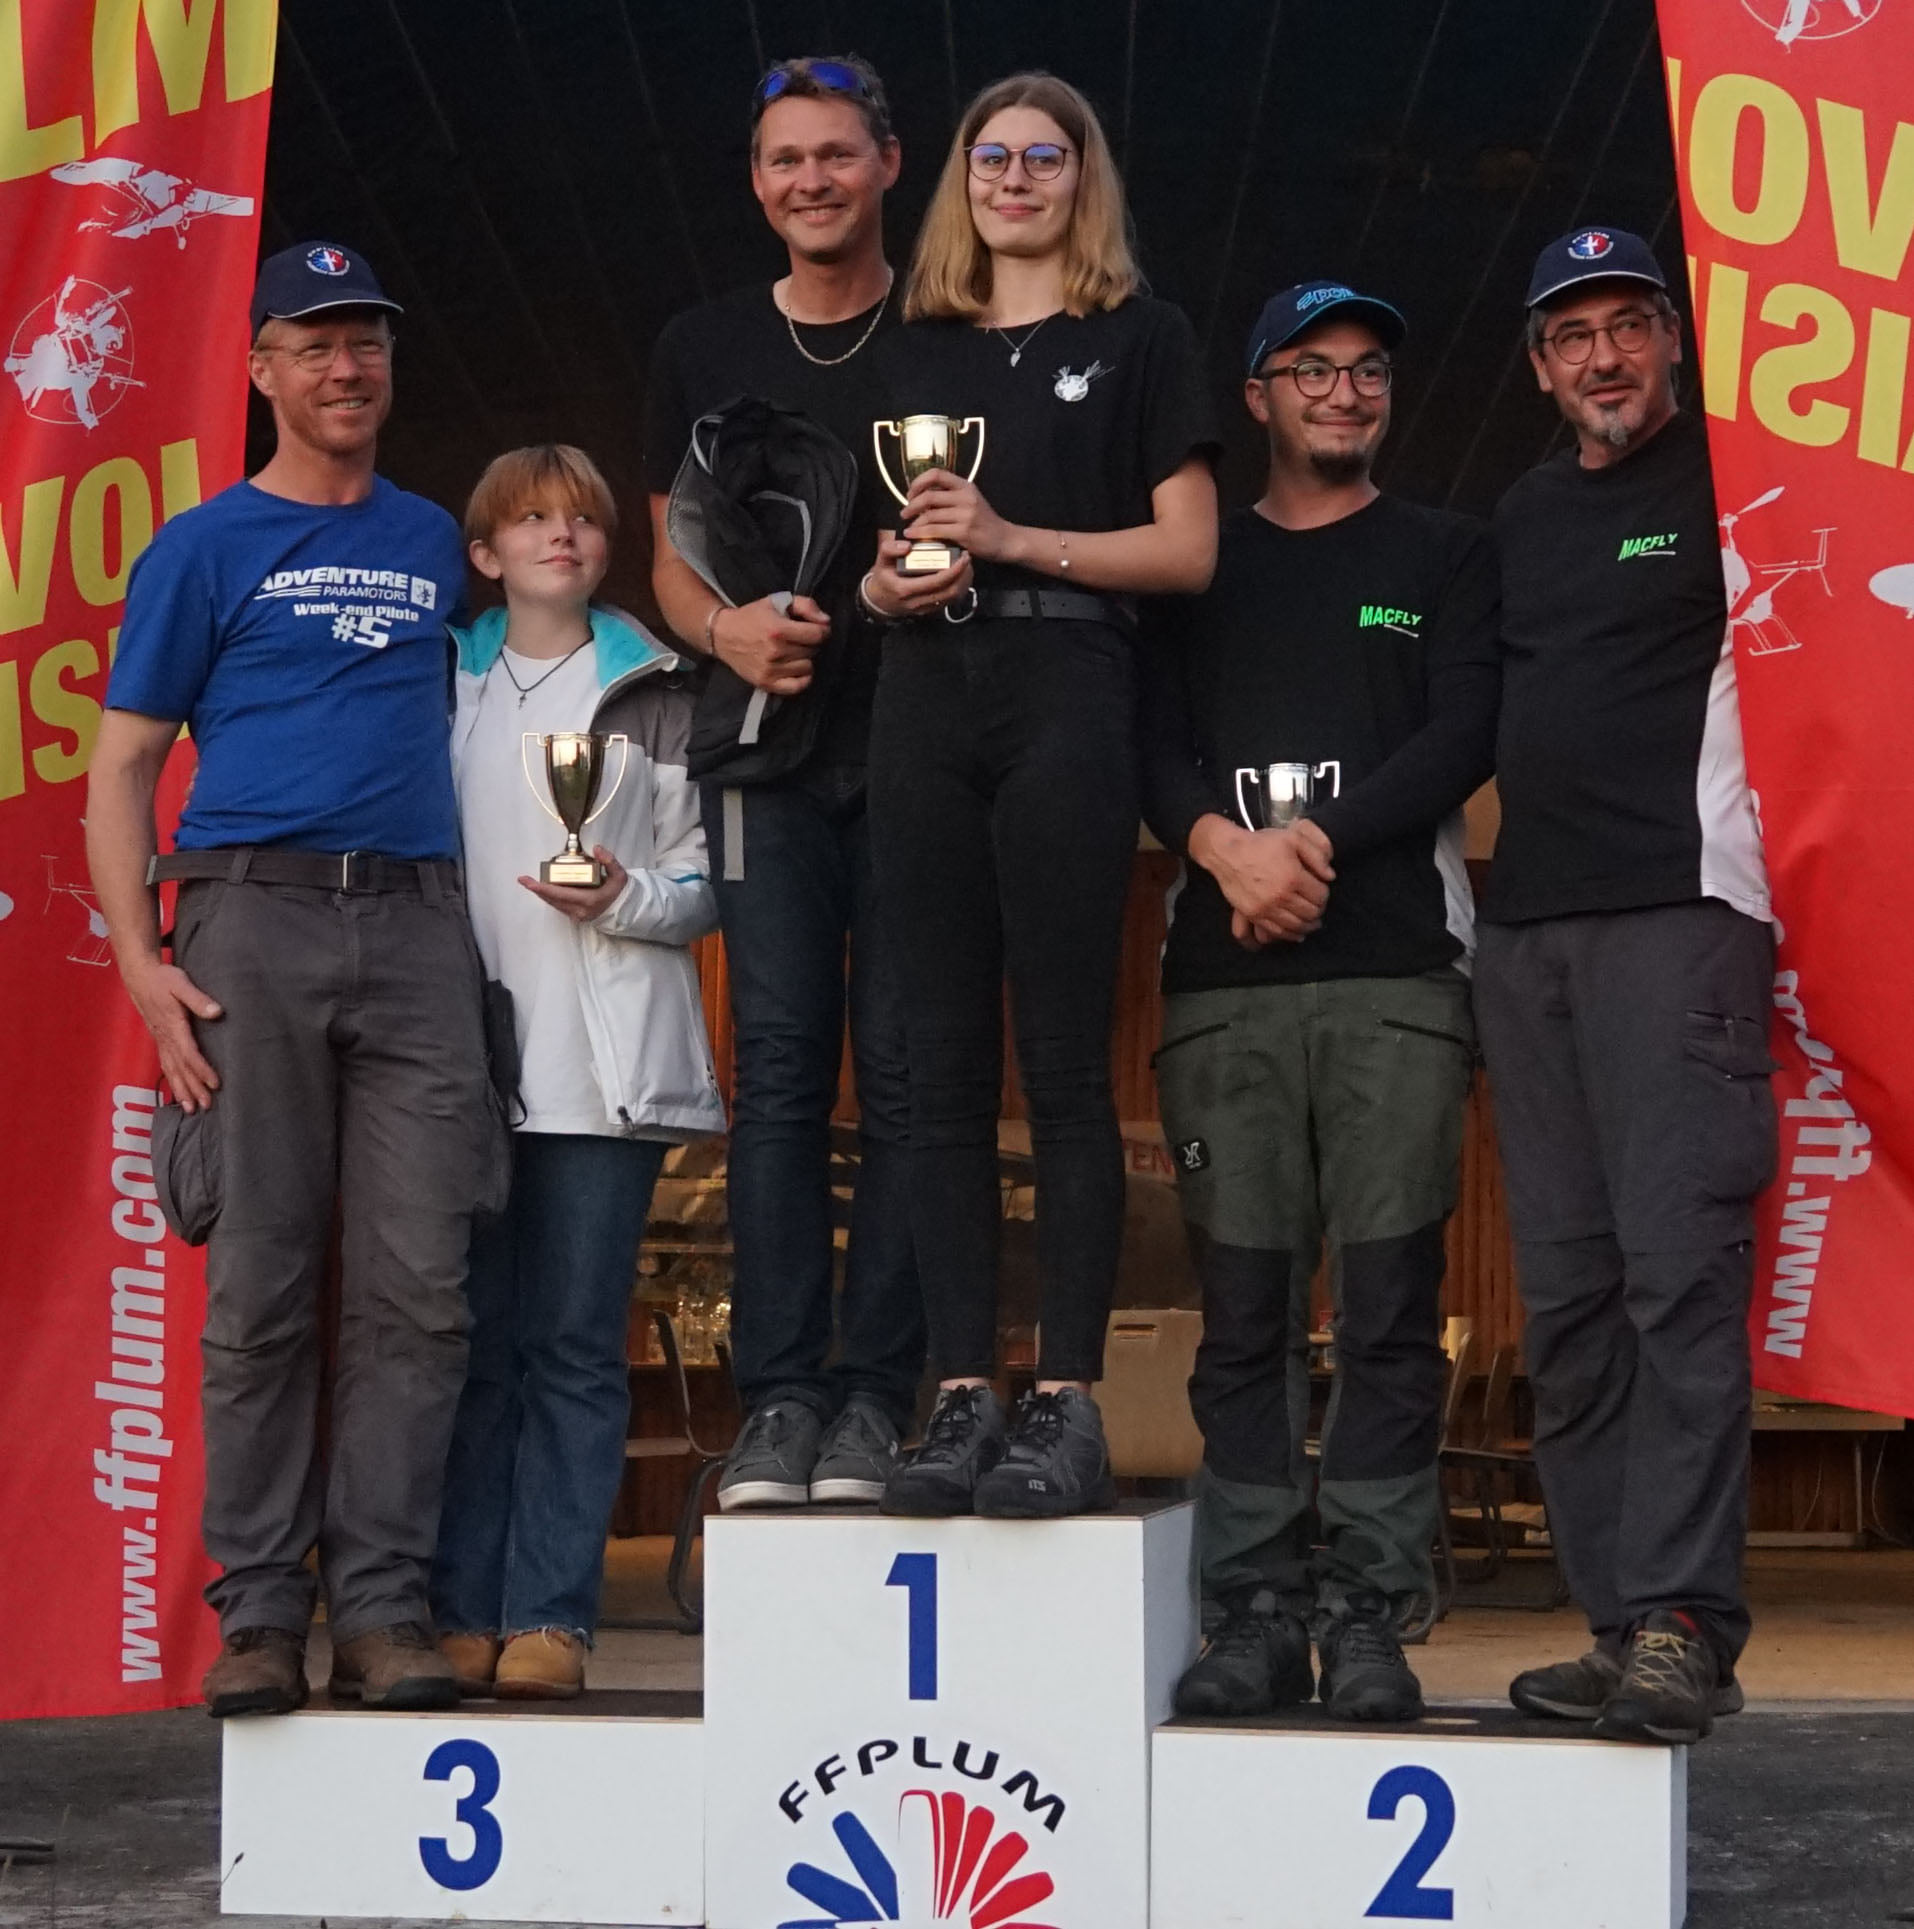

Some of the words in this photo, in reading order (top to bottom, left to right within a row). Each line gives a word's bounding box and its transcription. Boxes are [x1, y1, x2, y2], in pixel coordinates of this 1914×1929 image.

[1618, 533, 1678, 561] MACFLY
[259, 566, 409, 592] ADVENTURE
[322, 585, 408, 602] PARAMOTORS
[294, 602, 374, 618] Week-end
[375, 605, 420, 623] Pilote
[1359, 605, 1422, 628] MACFLY
[331, 613, 393, 649] #5
[94, 1084, 173, 1683] www.ffplum.com
[885, 1553, 938, 1700] 1
[778, 1736, 1067, 1834] FFPLUM
[419, 1738, 503, 1891] 3
[1363, 1765, 1456, 1921] 2
